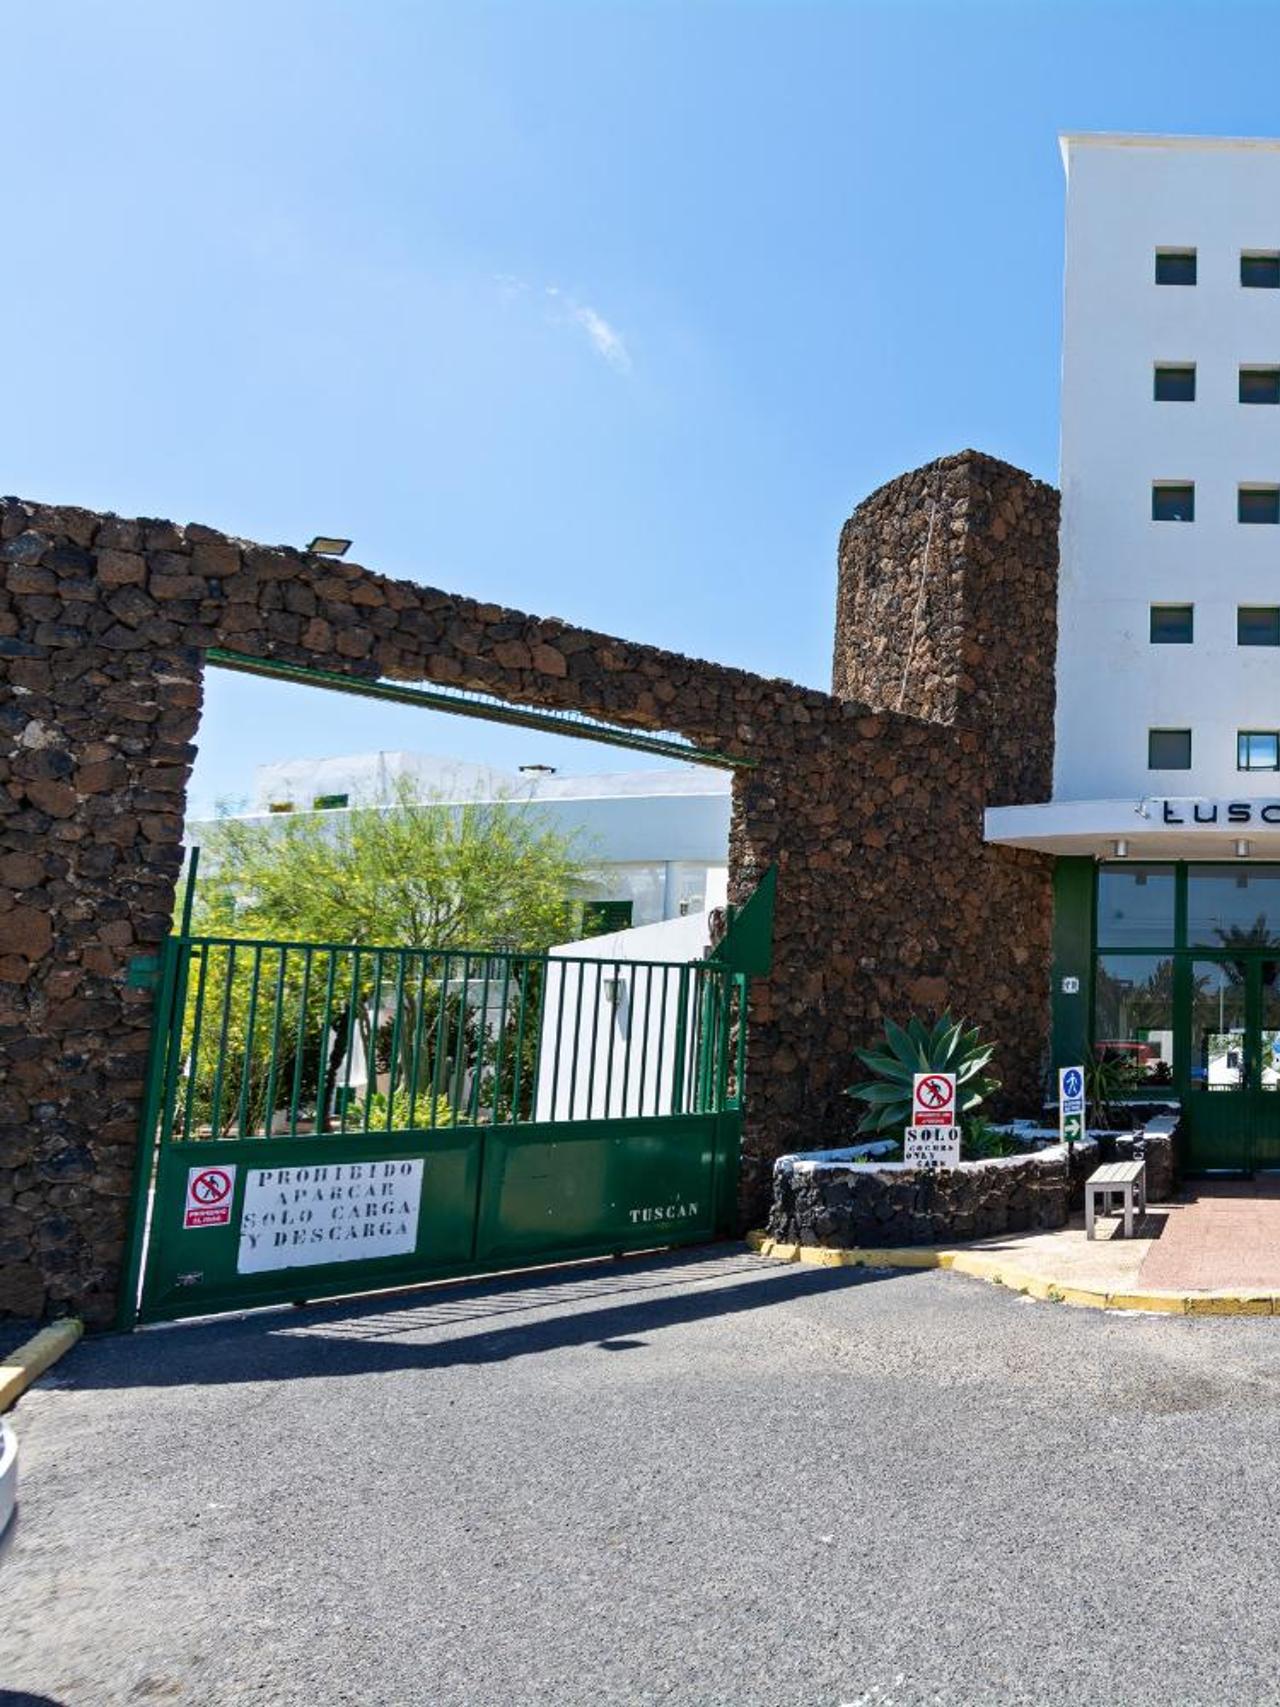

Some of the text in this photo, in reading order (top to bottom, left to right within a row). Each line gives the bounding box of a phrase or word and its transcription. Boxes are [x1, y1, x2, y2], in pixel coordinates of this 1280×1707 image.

[907, 1128, 958, 1141] SOLO
[258, 1163, 413, 1187] PROHIBIDO
[279, 1183, 394, 1205] APARCAR
[243, 1209, 313, 1229] SOLO
[331, 1201, 411, 1220] CARGA
[629, 1202, 699, 1223] TUSCAN
[248, 1222, 408, 1248] Y DESCARGA
